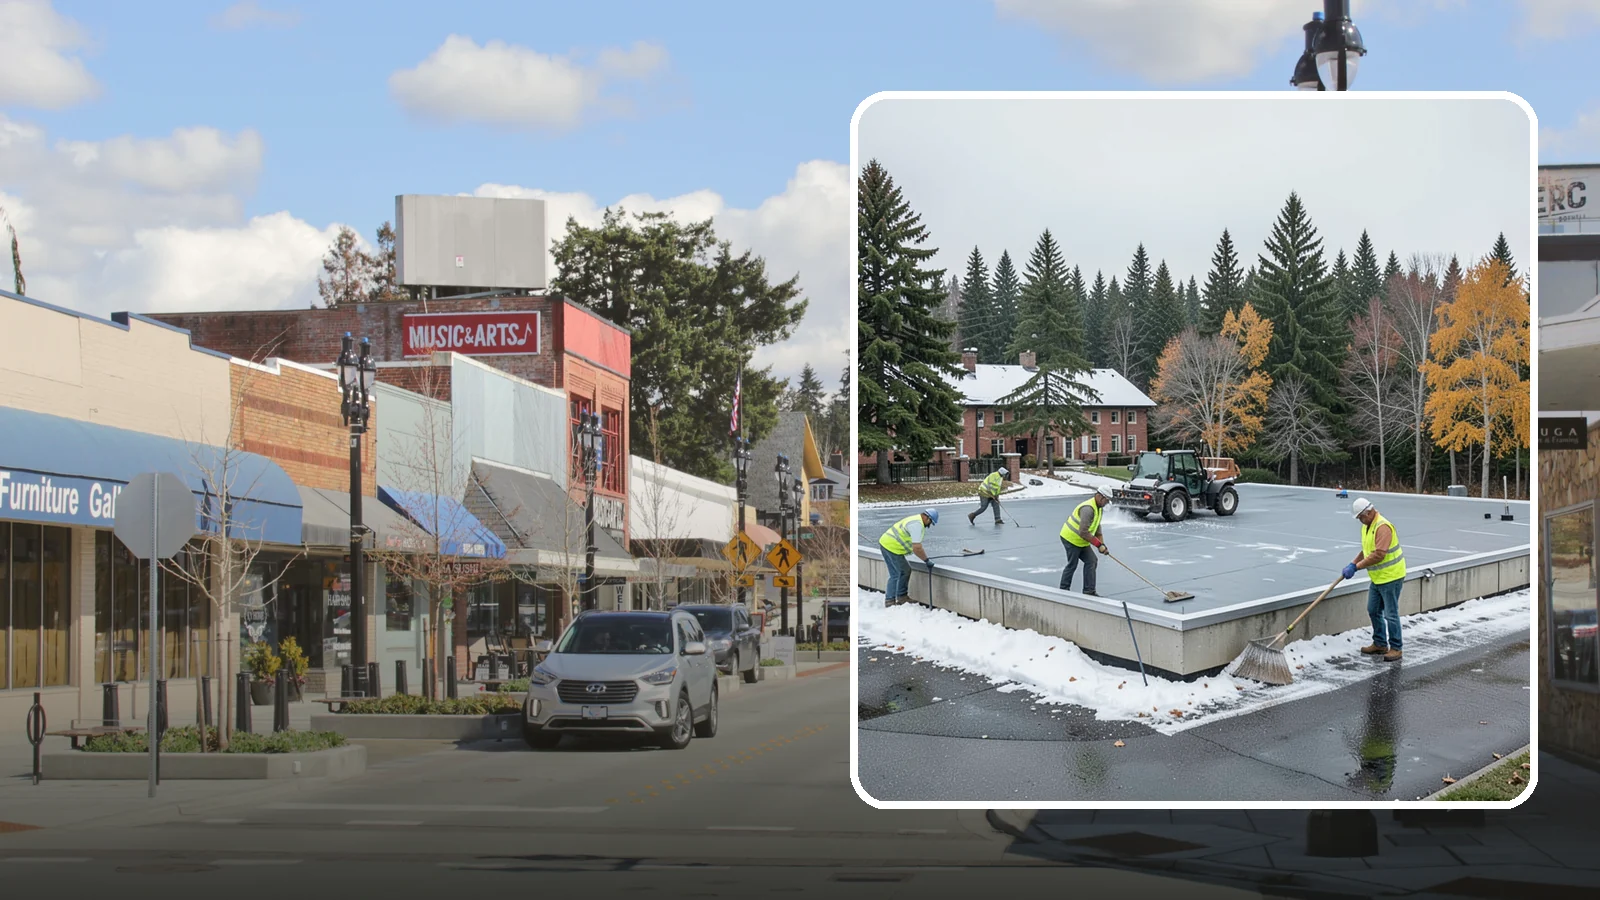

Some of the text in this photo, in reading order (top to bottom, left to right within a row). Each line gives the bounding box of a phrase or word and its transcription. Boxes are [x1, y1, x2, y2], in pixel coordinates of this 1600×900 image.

[409, 323, 519, 349] MUSIC&ARTS
[0, 472, 122, 519] Furniture Gal
